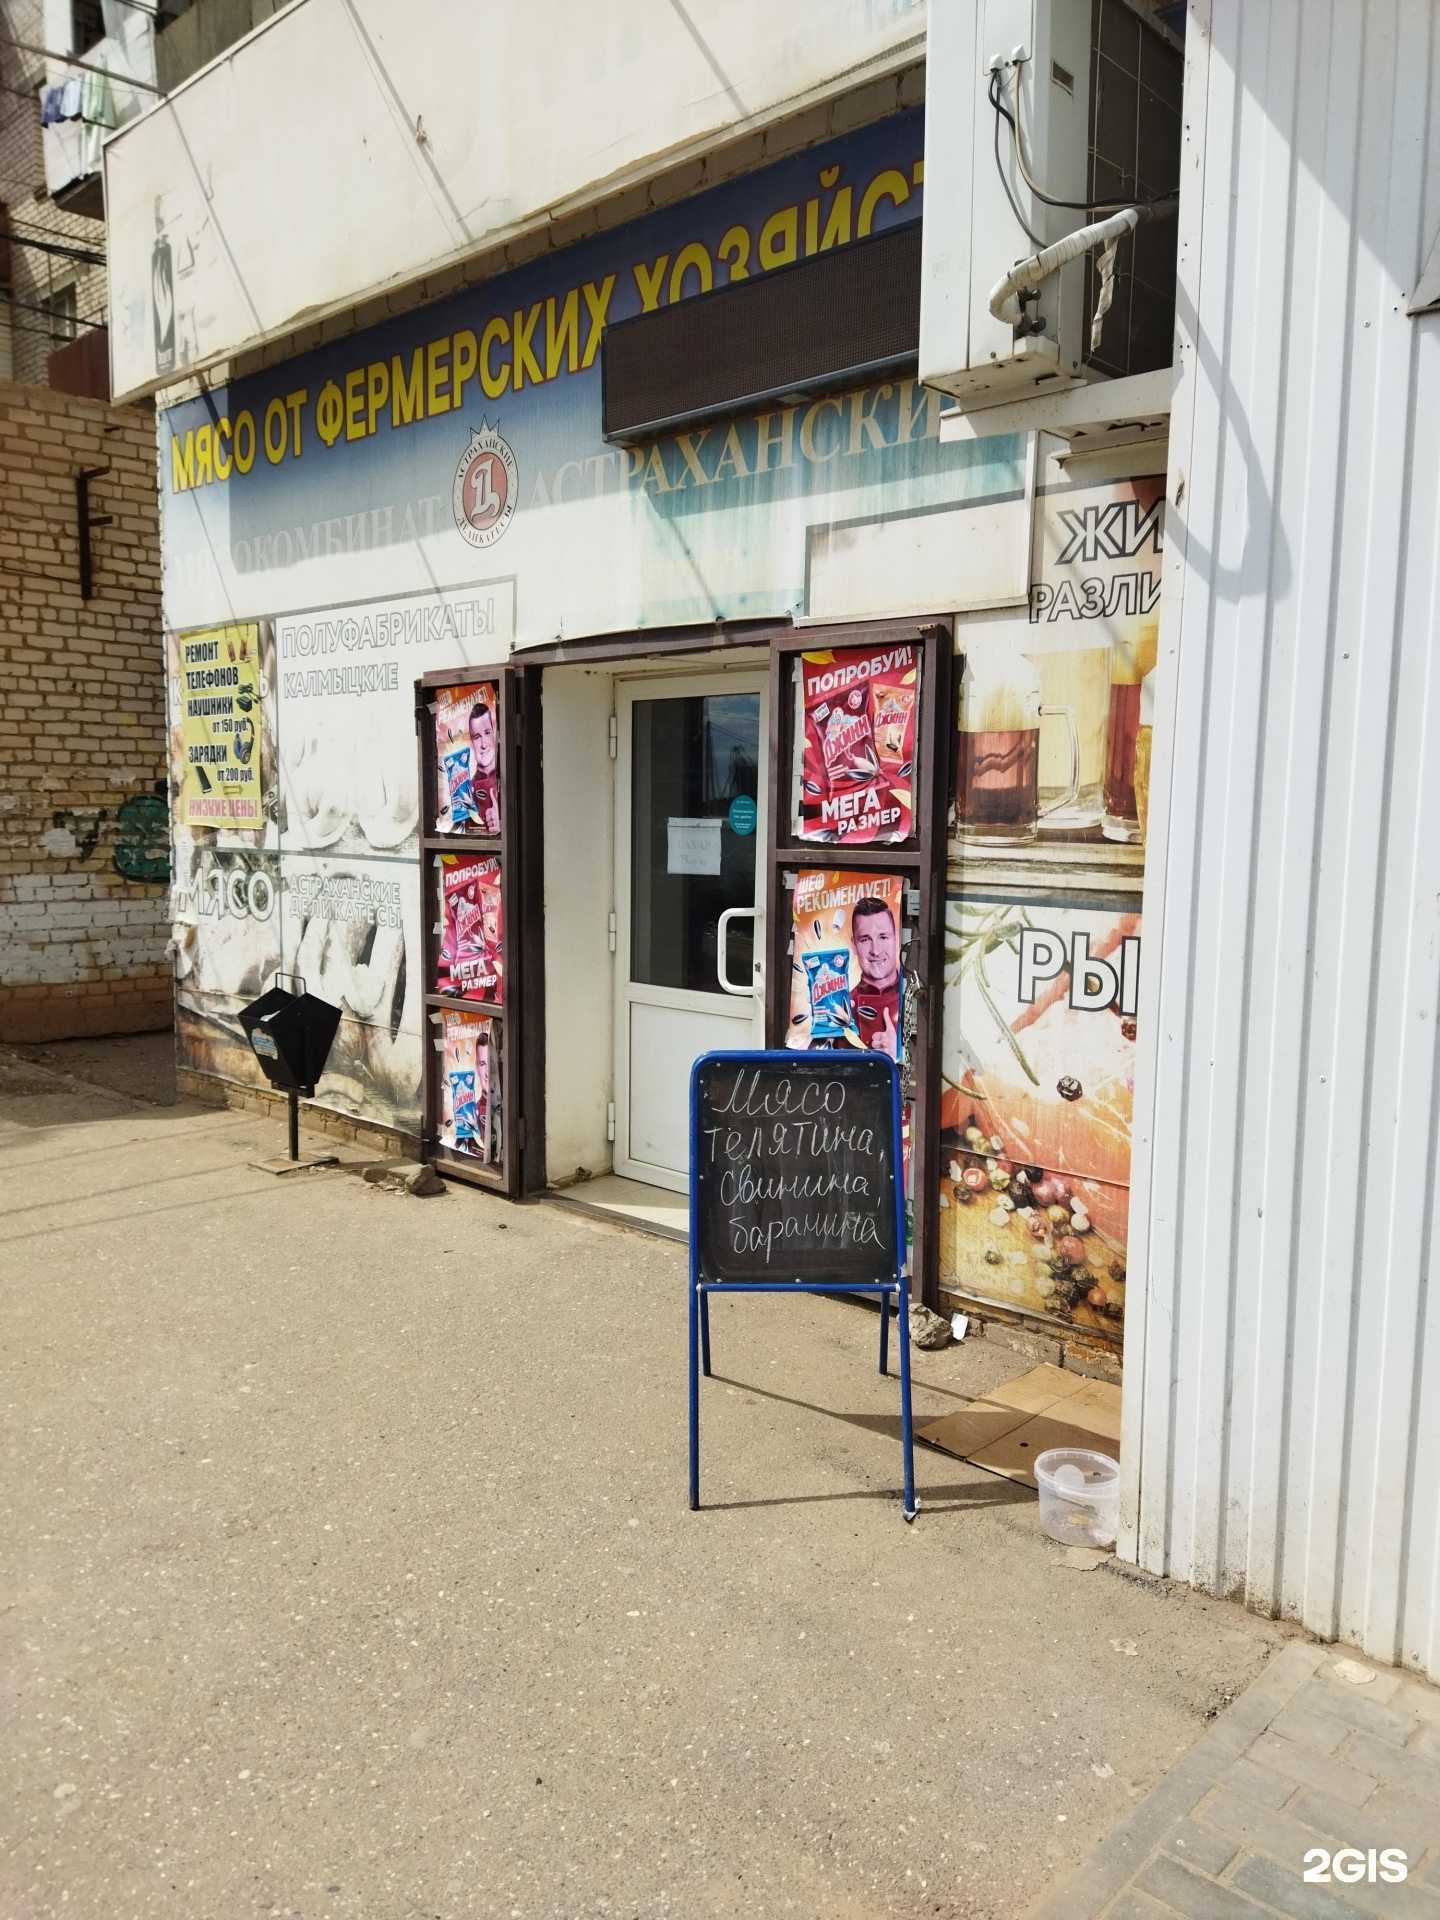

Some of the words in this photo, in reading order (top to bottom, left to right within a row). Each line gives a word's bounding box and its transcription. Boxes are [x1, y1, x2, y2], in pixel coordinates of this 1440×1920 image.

[171, 410, 257, 494] МЯСО
[263, 388, 309, 466] ОТ
[315, 273, 617, 448] ФЕРМЕРСКИХ
[632, 160, 923, 311] ХОЗЯЙС
[281, 598, 496, 658] ПОЛУФАБРИКАТЫ
[185, 641, 219, 664] РЕМОНТ
[186, 667, 239, 690] ТЕЛЕФОНОВ
[284, 662, 399, 699] КАЛМЫЦКИЕ
[808, 646, 913, 697] ПОПРОБУЙ!
[187, 696, 234, 717] НАУШНИКИ
[221, 719, 233, 733] 150
[189, 745, 227, 765] ЗАРЯДКИ
[225, 768, 239, 782] 200
[189, 800, 227, 817] НИЗКИЕ
[228, 800, 257, 817] ЦЕНЫ
[822, 788, 881, 824] МЕГА
[838, 808, 901, 835] РАЗМЕР
[445, 857, 499, 887] ПОПРОБУЙ!
[798, 873, 825, 894] ШЕФ
[177, 866, 274, 922] МЯСО
[288, 873, 401, 905] АСТРАХАНСКИЕ
[289, 896, 402, 929] ДЕЛИКАТЕСЫ
[450, 957, 488, 982] МЕГА
[461, 975, 497, 992] РАЗМЕР
[1017, 927, 1141, 1017] РЫ
[712, 1068, 846, 1115] Мясо
